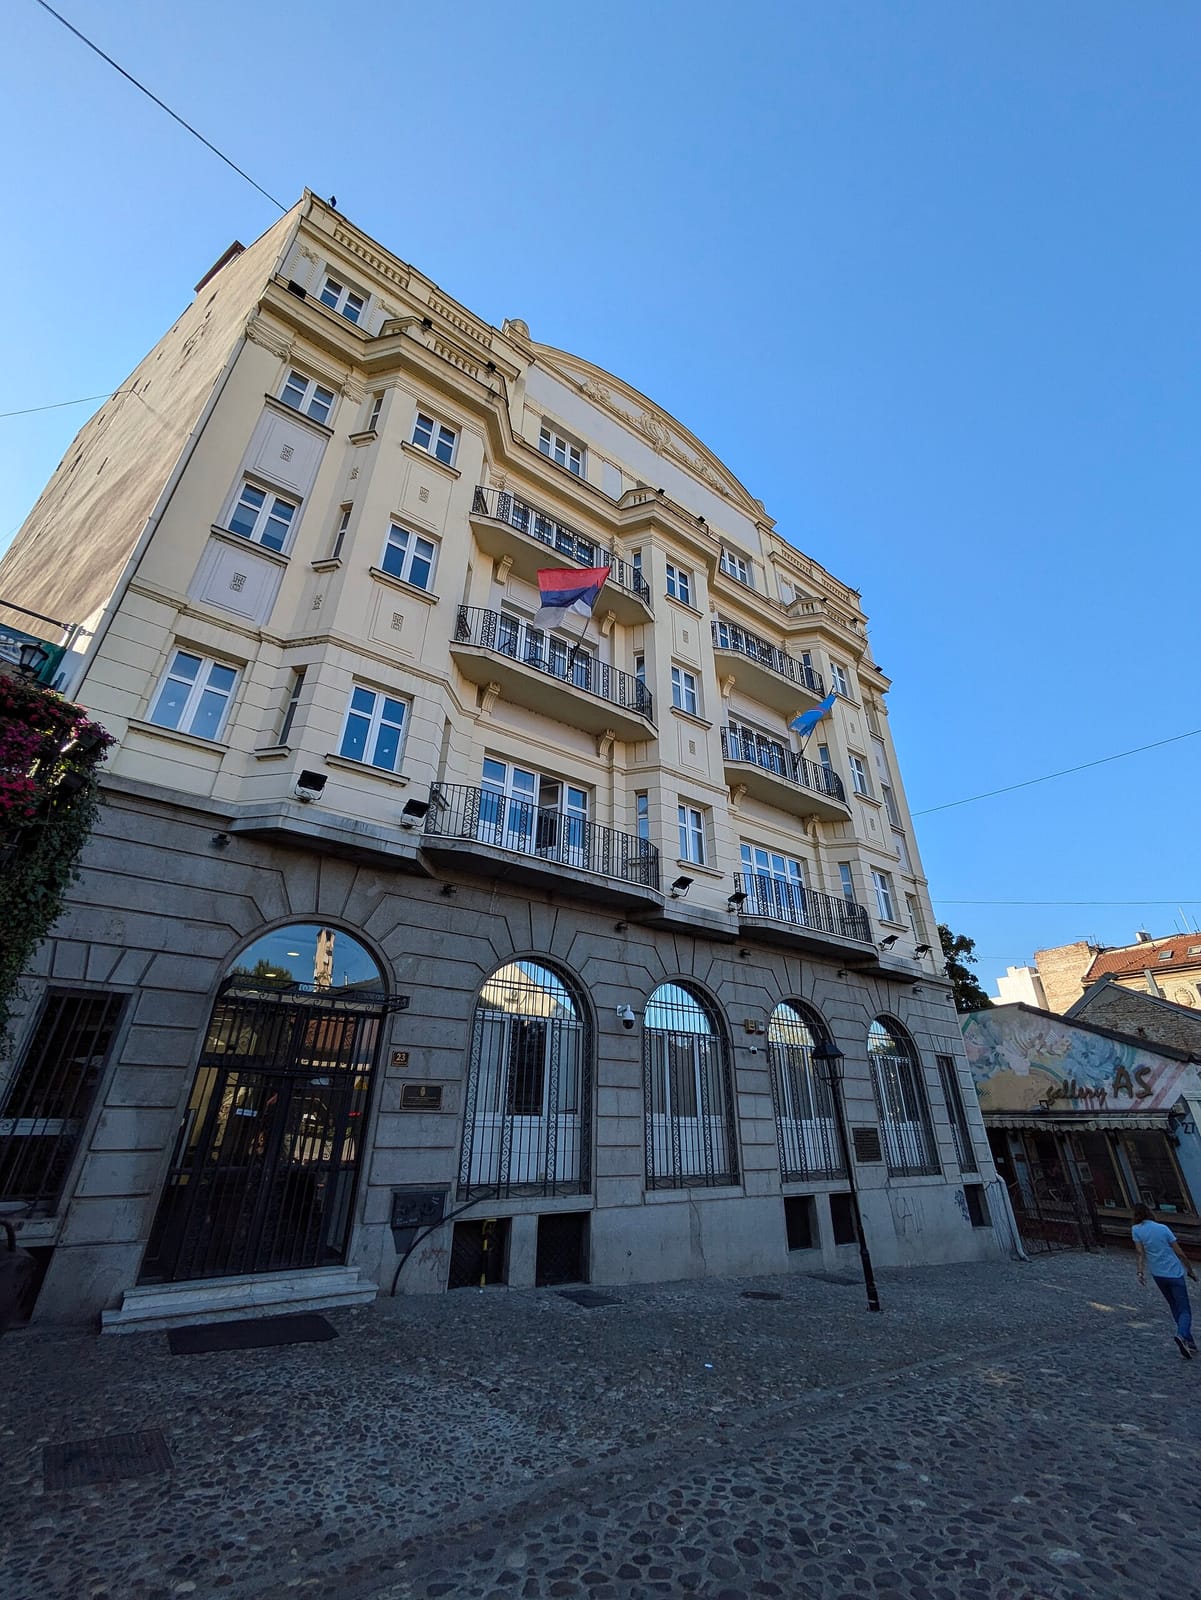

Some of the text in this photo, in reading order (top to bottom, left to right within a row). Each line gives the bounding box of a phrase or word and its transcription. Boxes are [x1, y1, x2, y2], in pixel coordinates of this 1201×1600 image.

[395, 1053, 406, 1062] 23
[1046, 1065, 1153, 1104] gallery AS
